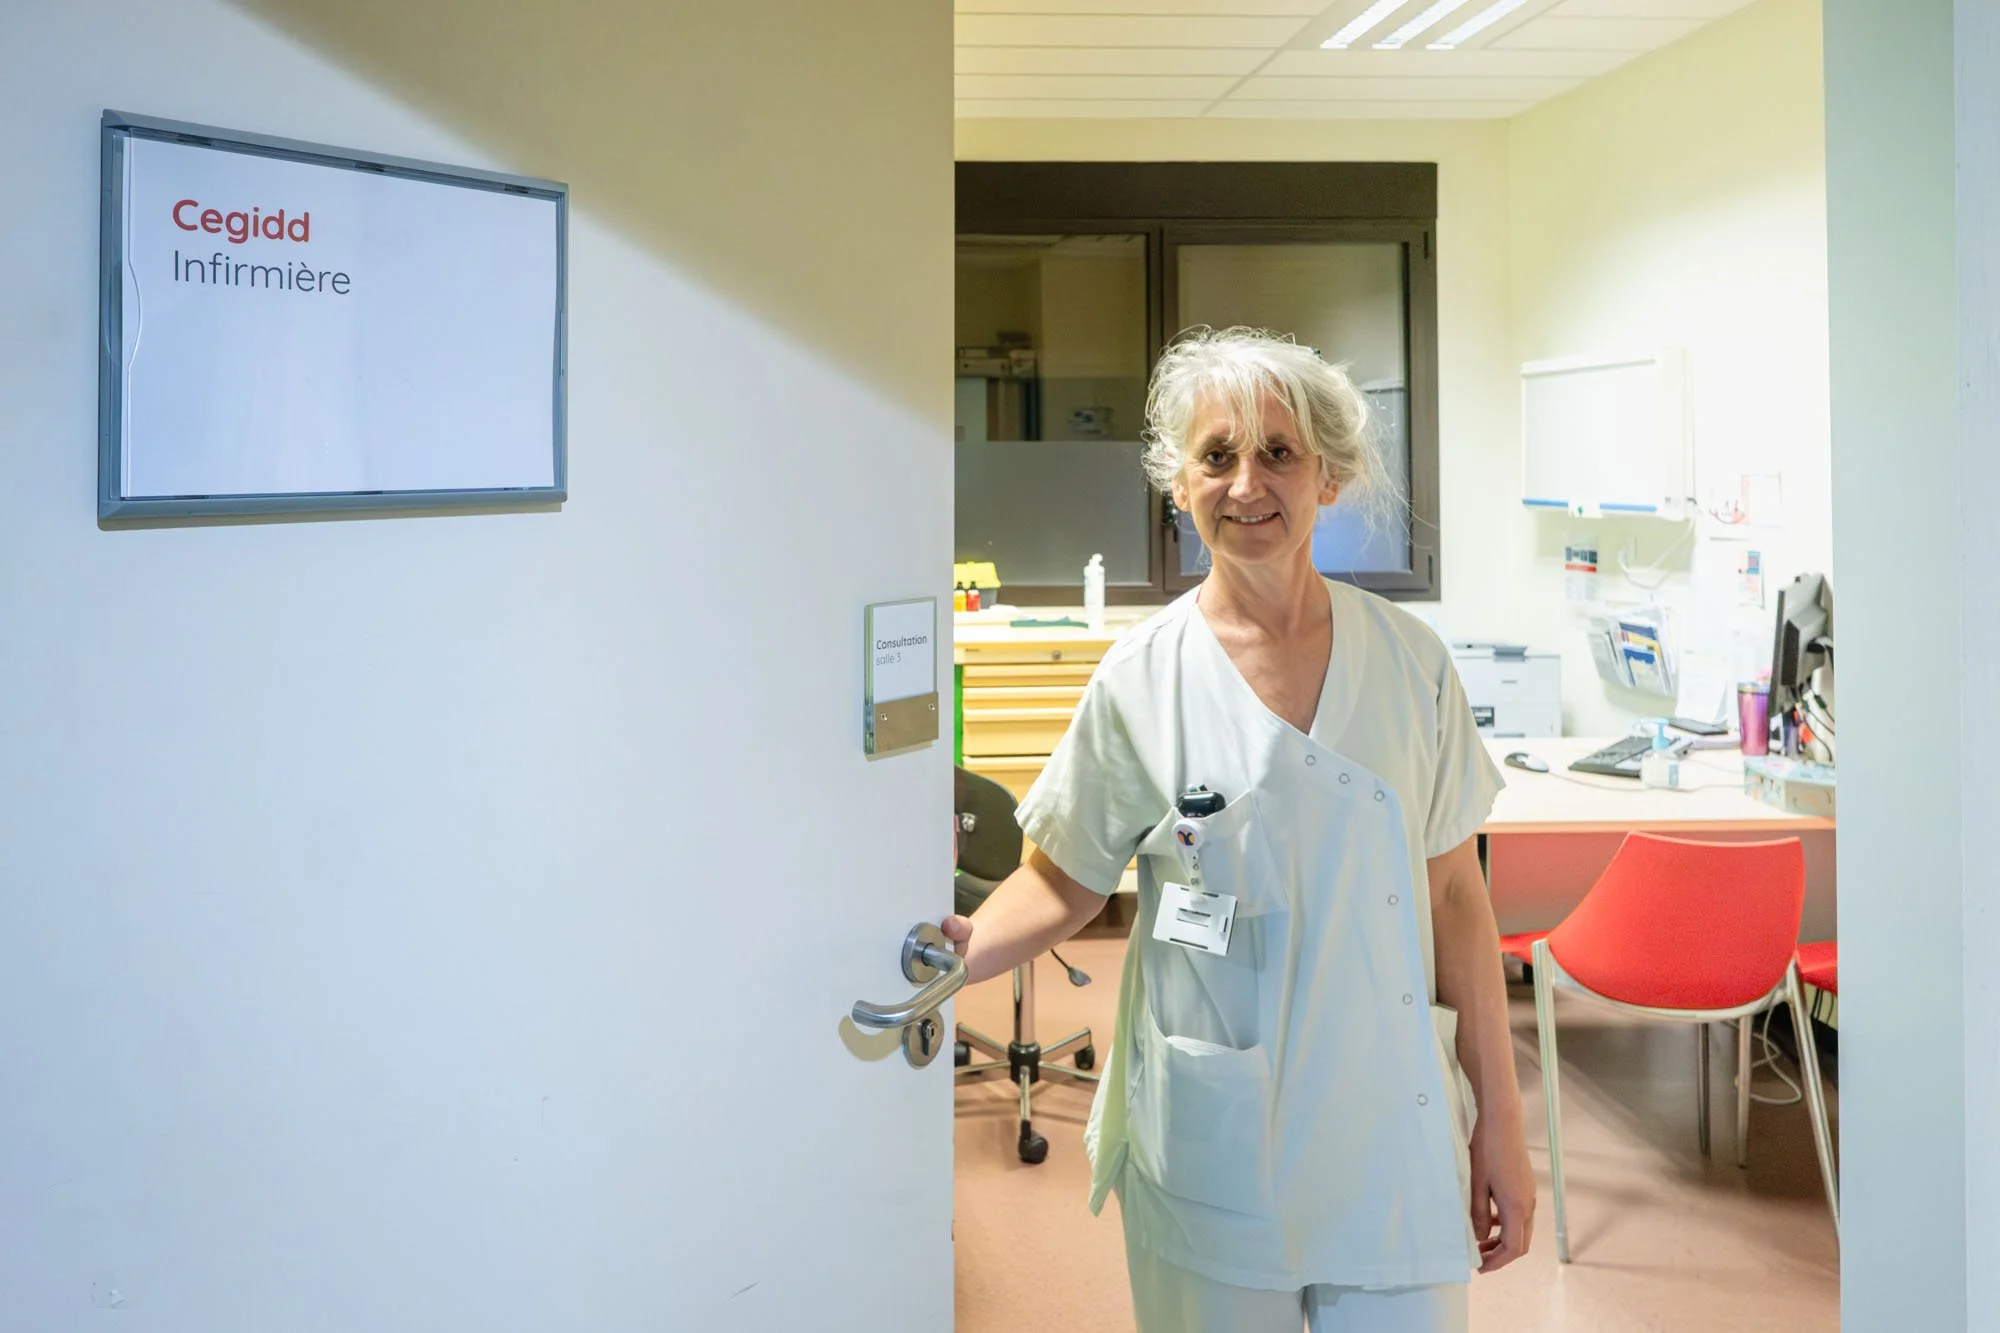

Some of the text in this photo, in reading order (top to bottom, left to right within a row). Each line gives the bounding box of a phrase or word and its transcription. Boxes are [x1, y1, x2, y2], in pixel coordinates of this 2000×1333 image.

[173, 199, 310, 244] Cegidd
[174, 250, 351, 295] Infirmière
[876, 635, 927, 650] Consultation
[876, 652, 902, 666] salle 3
